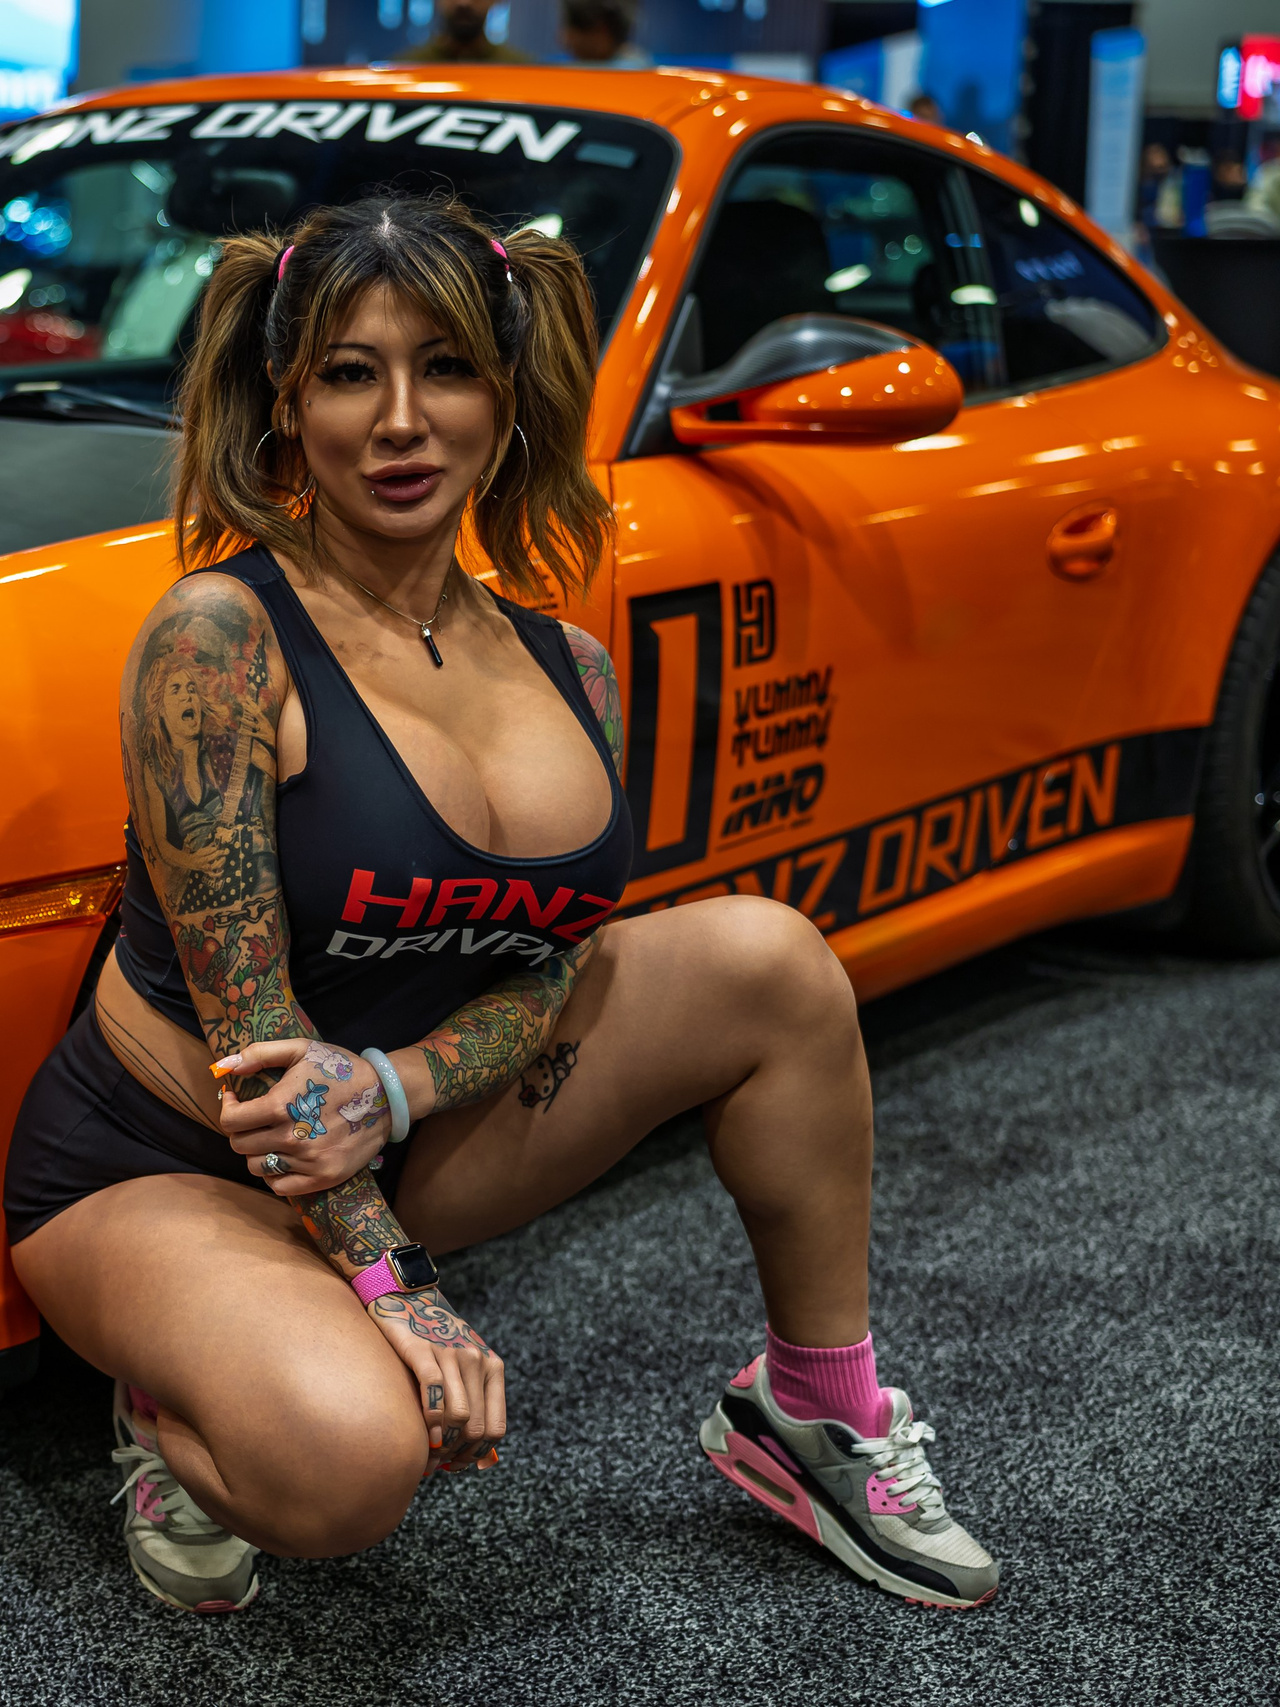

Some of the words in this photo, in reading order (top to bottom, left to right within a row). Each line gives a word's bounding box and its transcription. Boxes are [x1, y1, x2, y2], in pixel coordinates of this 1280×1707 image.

[190, 103, 581, 163] DRIVEN
[858, 743, 1120, 914] DRIVEN
[341, 868, 618, 944] HANZ
[326, 928, 566, 966] DRIVEN
